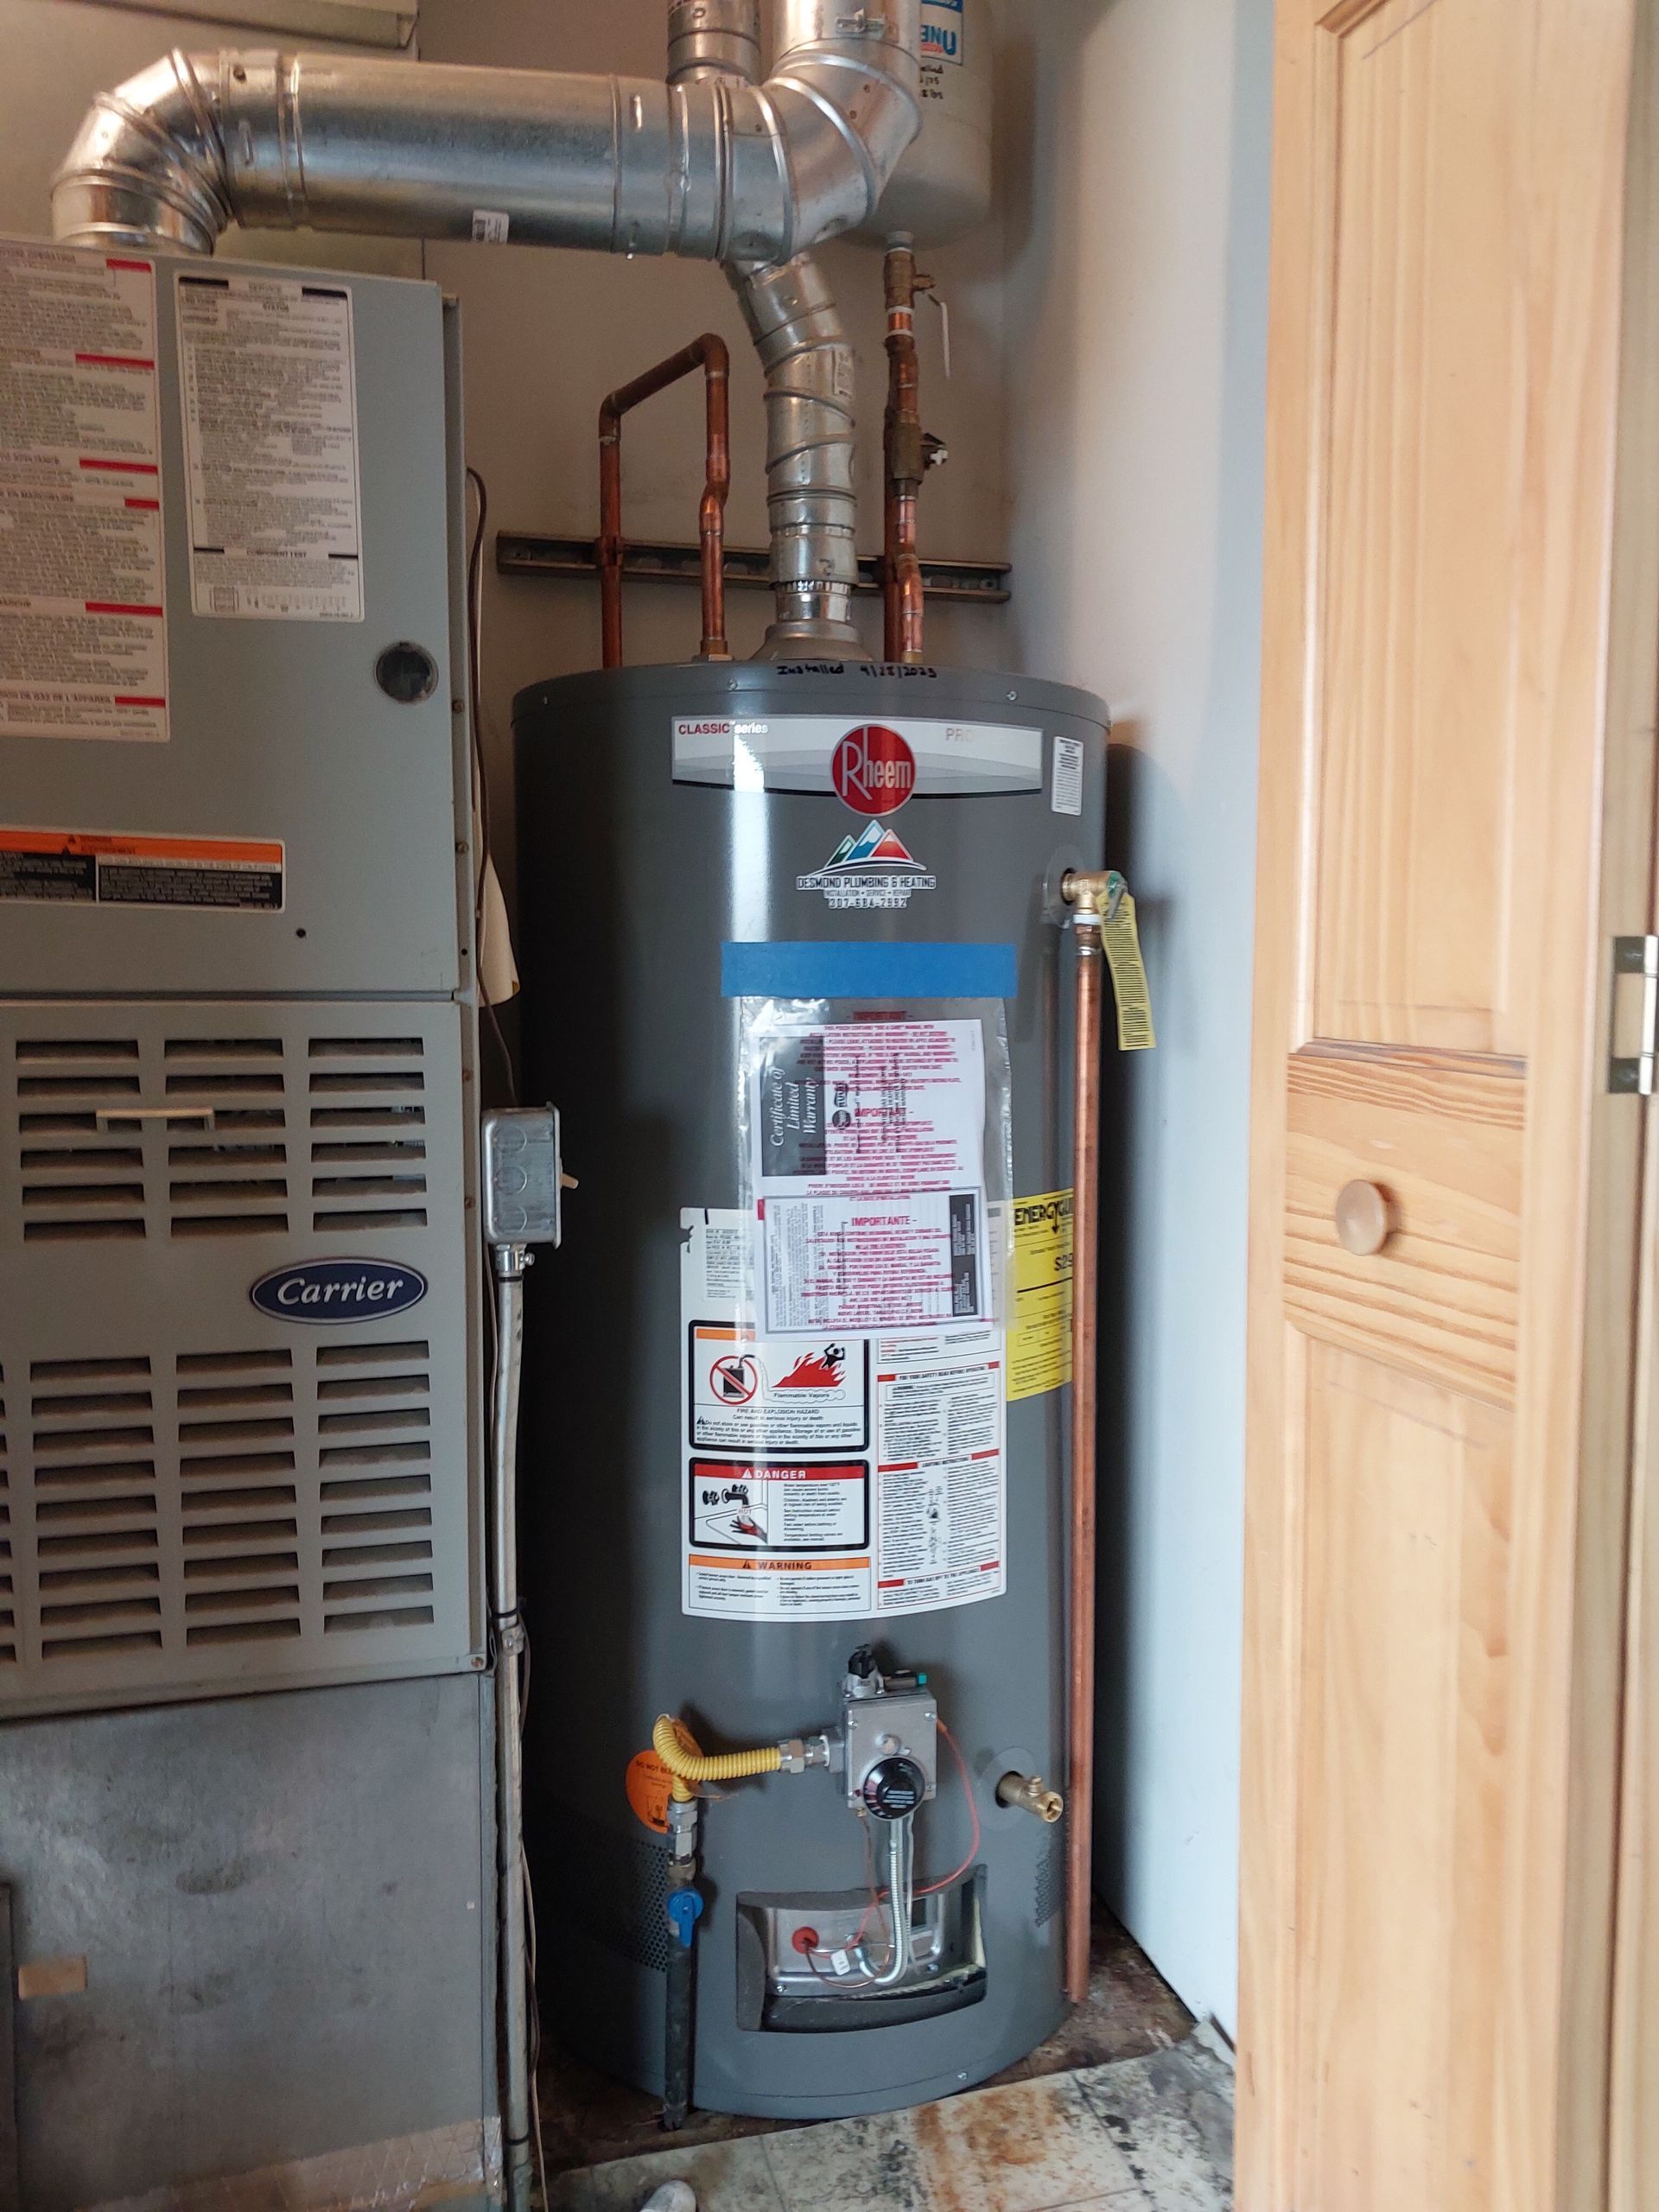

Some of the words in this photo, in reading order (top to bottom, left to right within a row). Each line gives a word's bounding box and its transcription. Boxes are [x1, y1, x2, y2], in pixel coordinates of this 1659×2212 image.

[678, 723, 730, 735] CLASSIC
[734, 721, 769, 734] series
[842, 727, 912, 801] Rheem
[797, 877, 842, 889] DESMOND
[842, 877, 889, 888] PLUMBING
[899, 877, 937, 888] HEATING
[769, 1081, 785, 1147] Certificate
[785, 1082, 801, 1130] Limited
[802, 1077, 819, 1134] Warranty
[851, 1216, 911, 1226] IMPORTANTE
[276, 1275, 404, 1306] Carrier
[753, 1470, 806, 1479] DANGER
